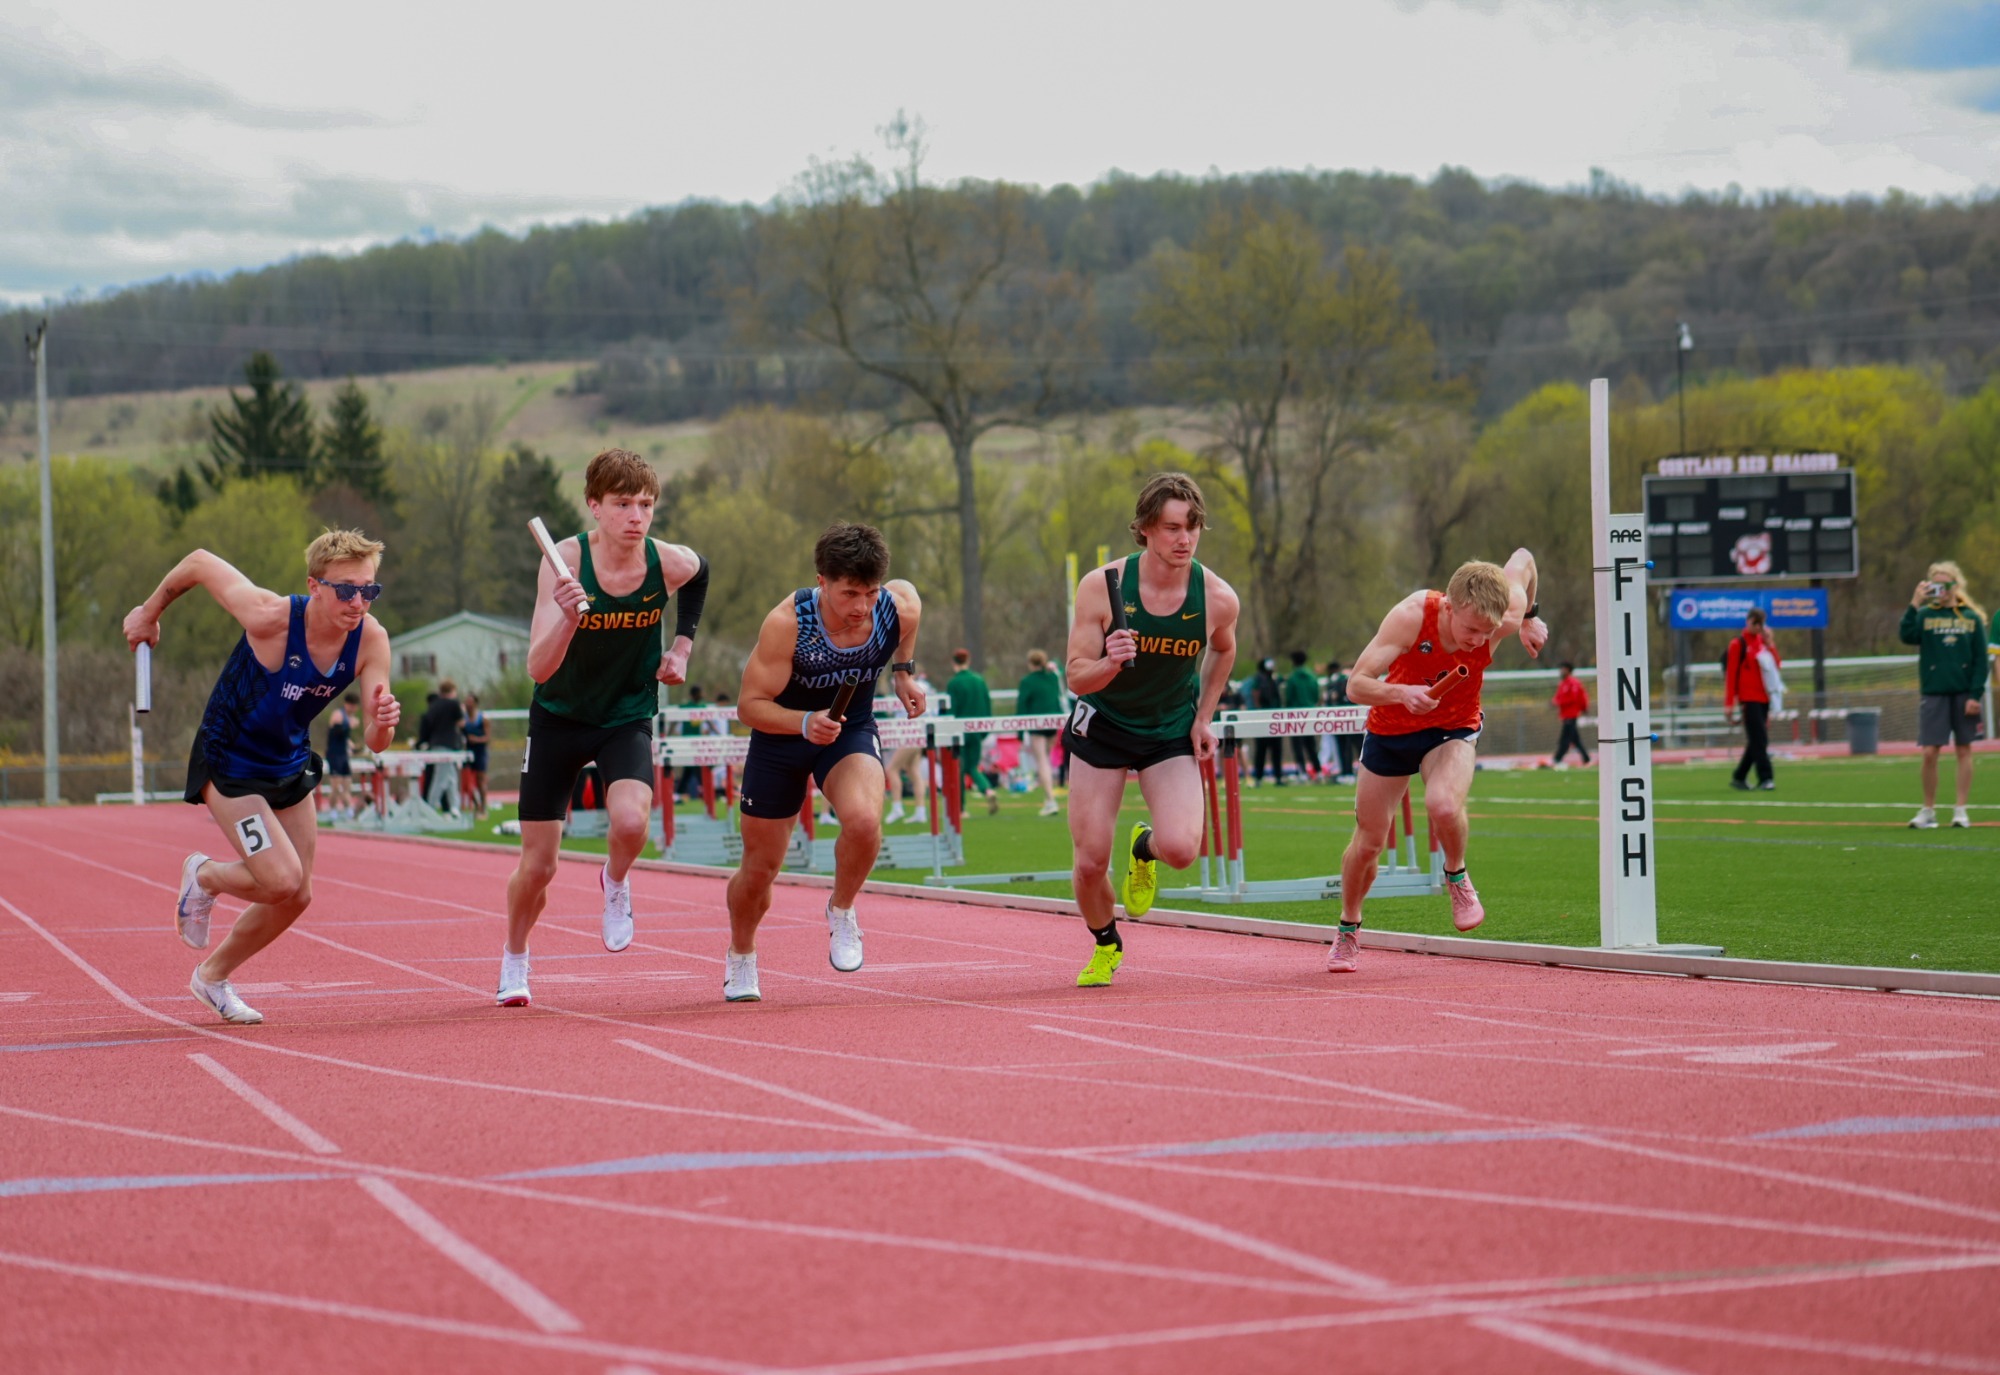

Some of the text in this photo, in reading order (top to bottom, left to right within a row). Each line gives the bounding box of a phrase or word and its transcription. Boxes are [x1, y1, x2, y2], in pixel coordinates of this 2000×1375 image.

[579, 608, 661, 630] OSWEGO
[1132, 636, 1200, 656] WEGO
[964, 720, 995, 732] SUNY
[1072, 704, 1088, 735] 2
[1614, 557, 1647, 877] FINISH
[1268, 722, 1307, 735] SUNY
[241, 817, 263, 853] 5
